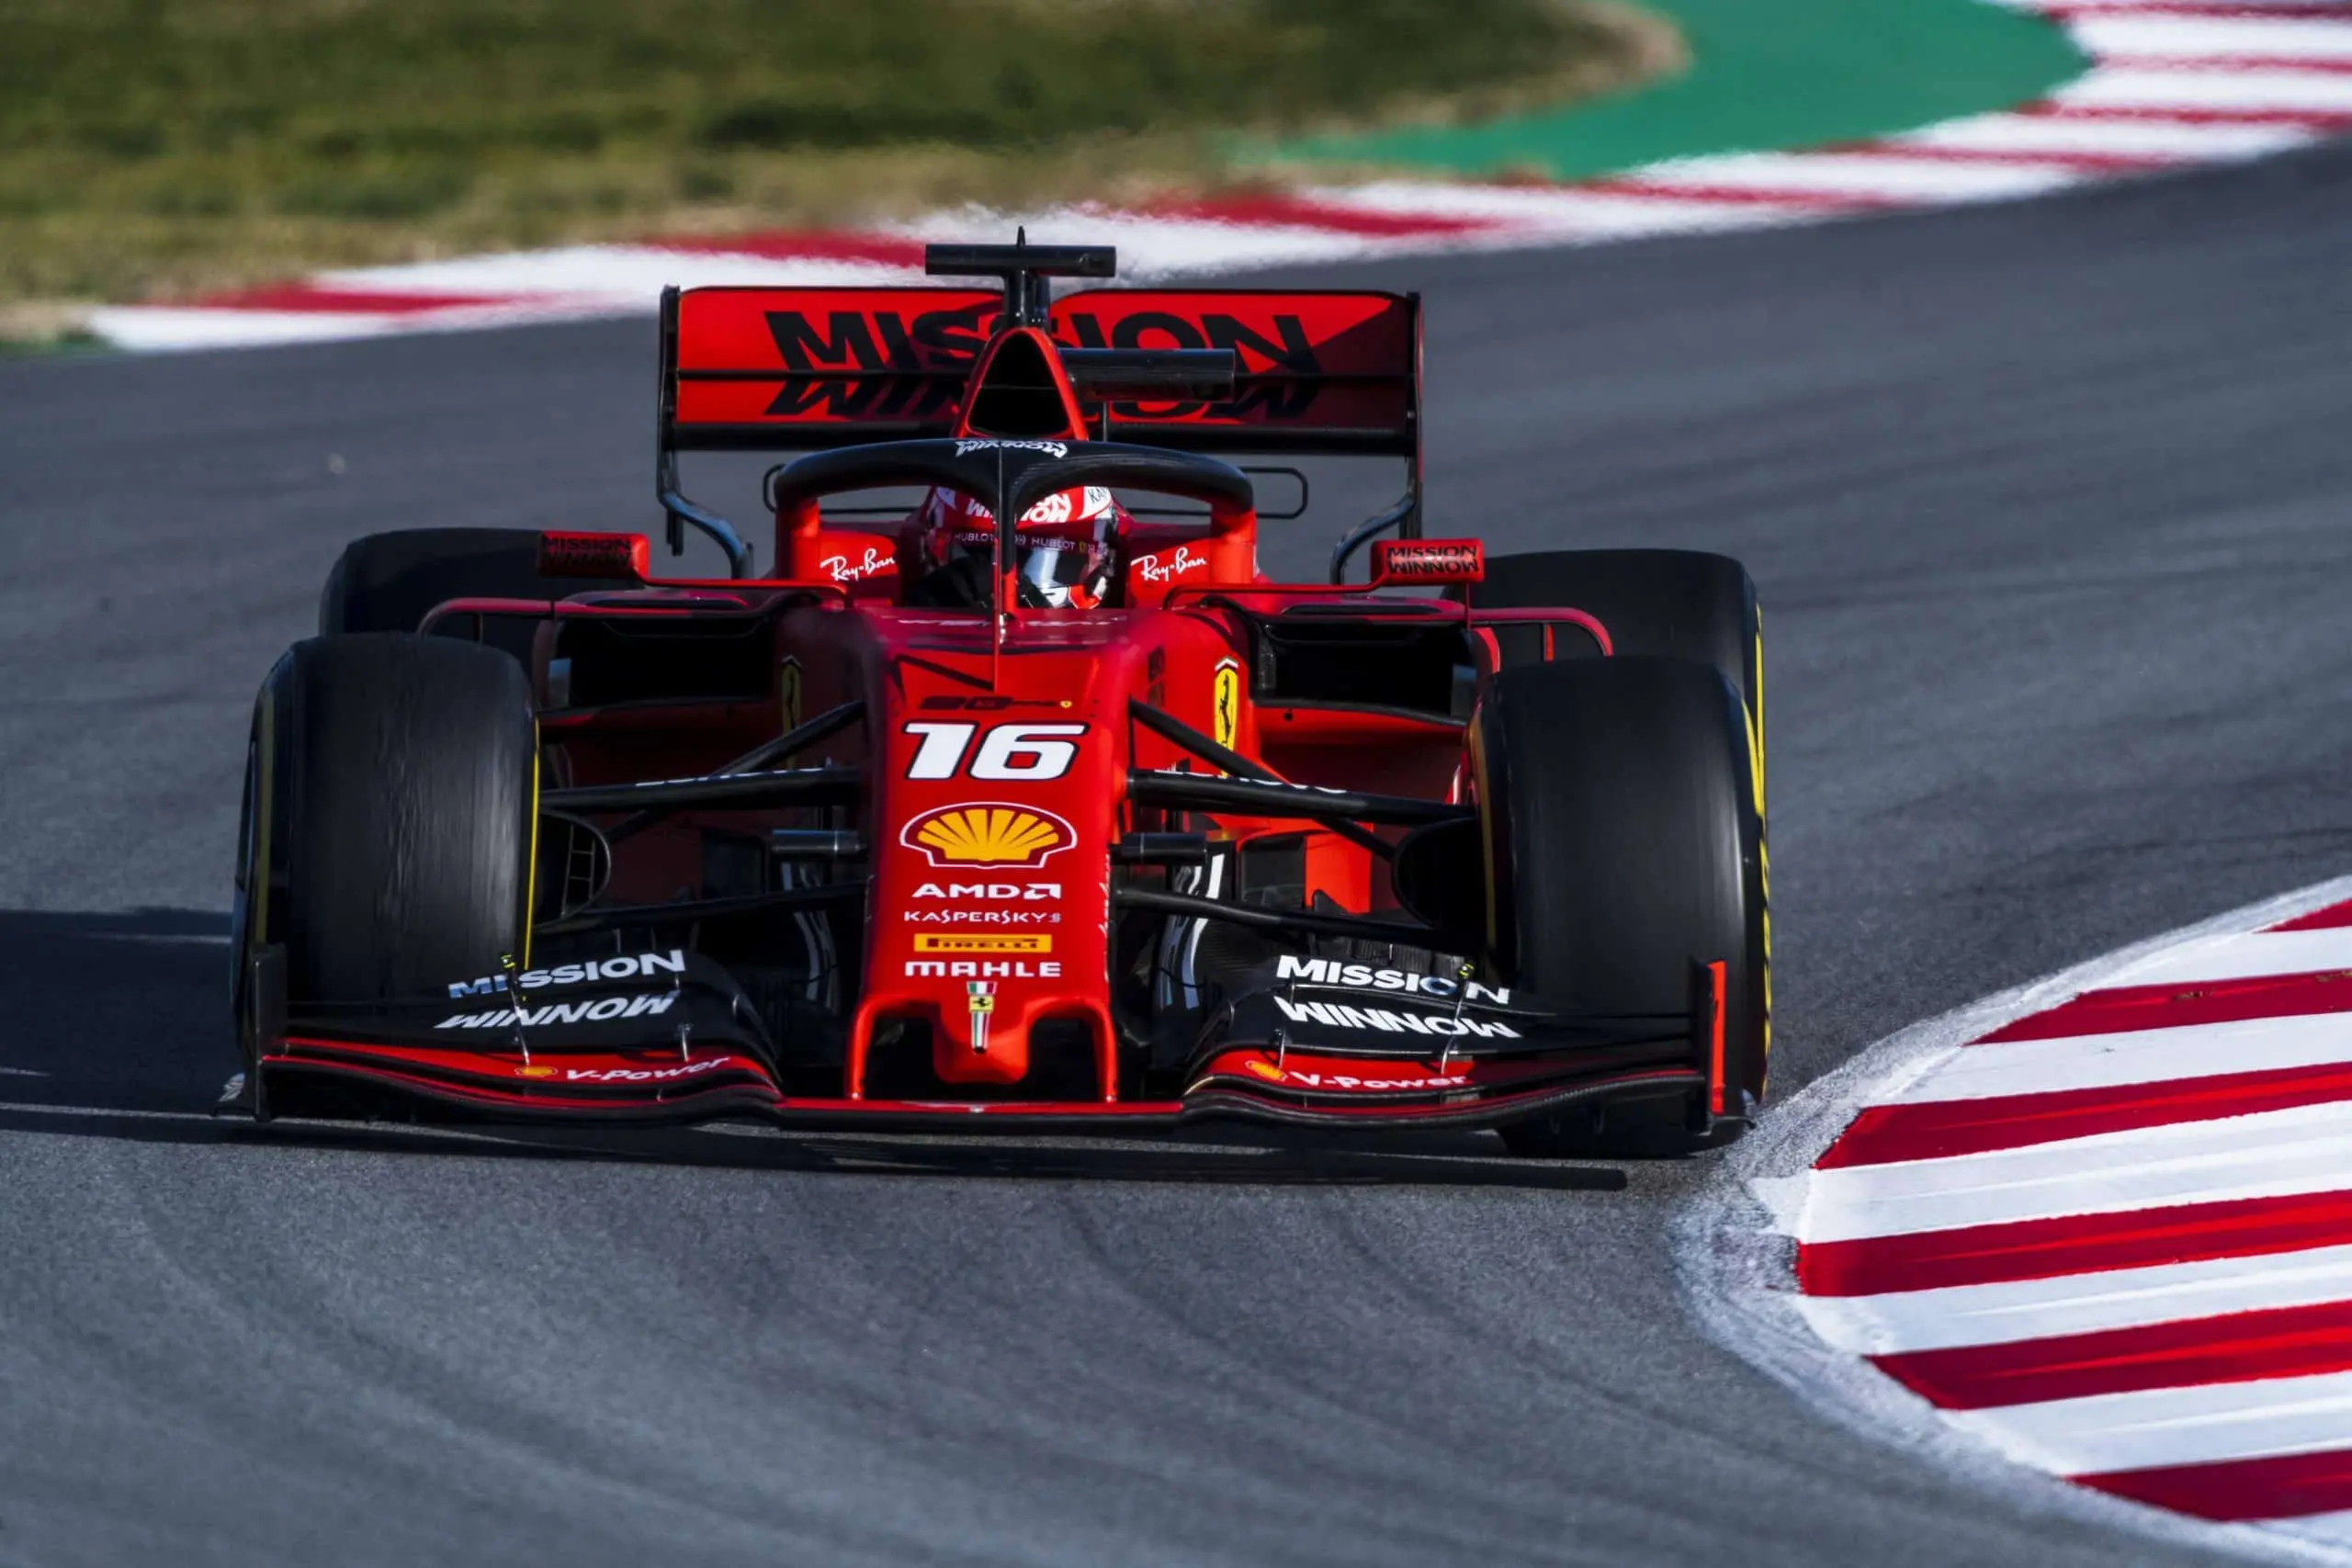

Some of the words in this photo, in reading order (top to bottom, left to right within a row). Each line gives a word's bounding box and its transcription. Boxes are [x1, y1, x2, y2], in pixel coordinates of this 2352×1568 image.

[763, 310, 1320, 372] MISION
[1031, 537, 1076, 551] HUBLOT
[1388, 546, 1477, 557] MISSION
[820, 547, 896, 581] Ray-Ban
[1130, 547, 1207, 582] Ray-Ban
[1388, 560, 1480, 574] WINNOW
[904, 722, 1088, 781] 16
[911, 883, 1022, 899] AMD
[903, 908, 1048, 924] KASPERSKY
[926, 937, 1040, 949] PIRELLI
[447, 949, 686, 998] MISSION
[904, 961, 1062, 977] MAHLE
[1276, 954, 1510, 1005] MISSION
[433, 989, 682, 1029] WINNOW
[1273, 995, 1523, 1038] WINNOW
[566, 1056, 729, 1081] V-Power
[1289, 1071, 1467, 1089] V-Power
